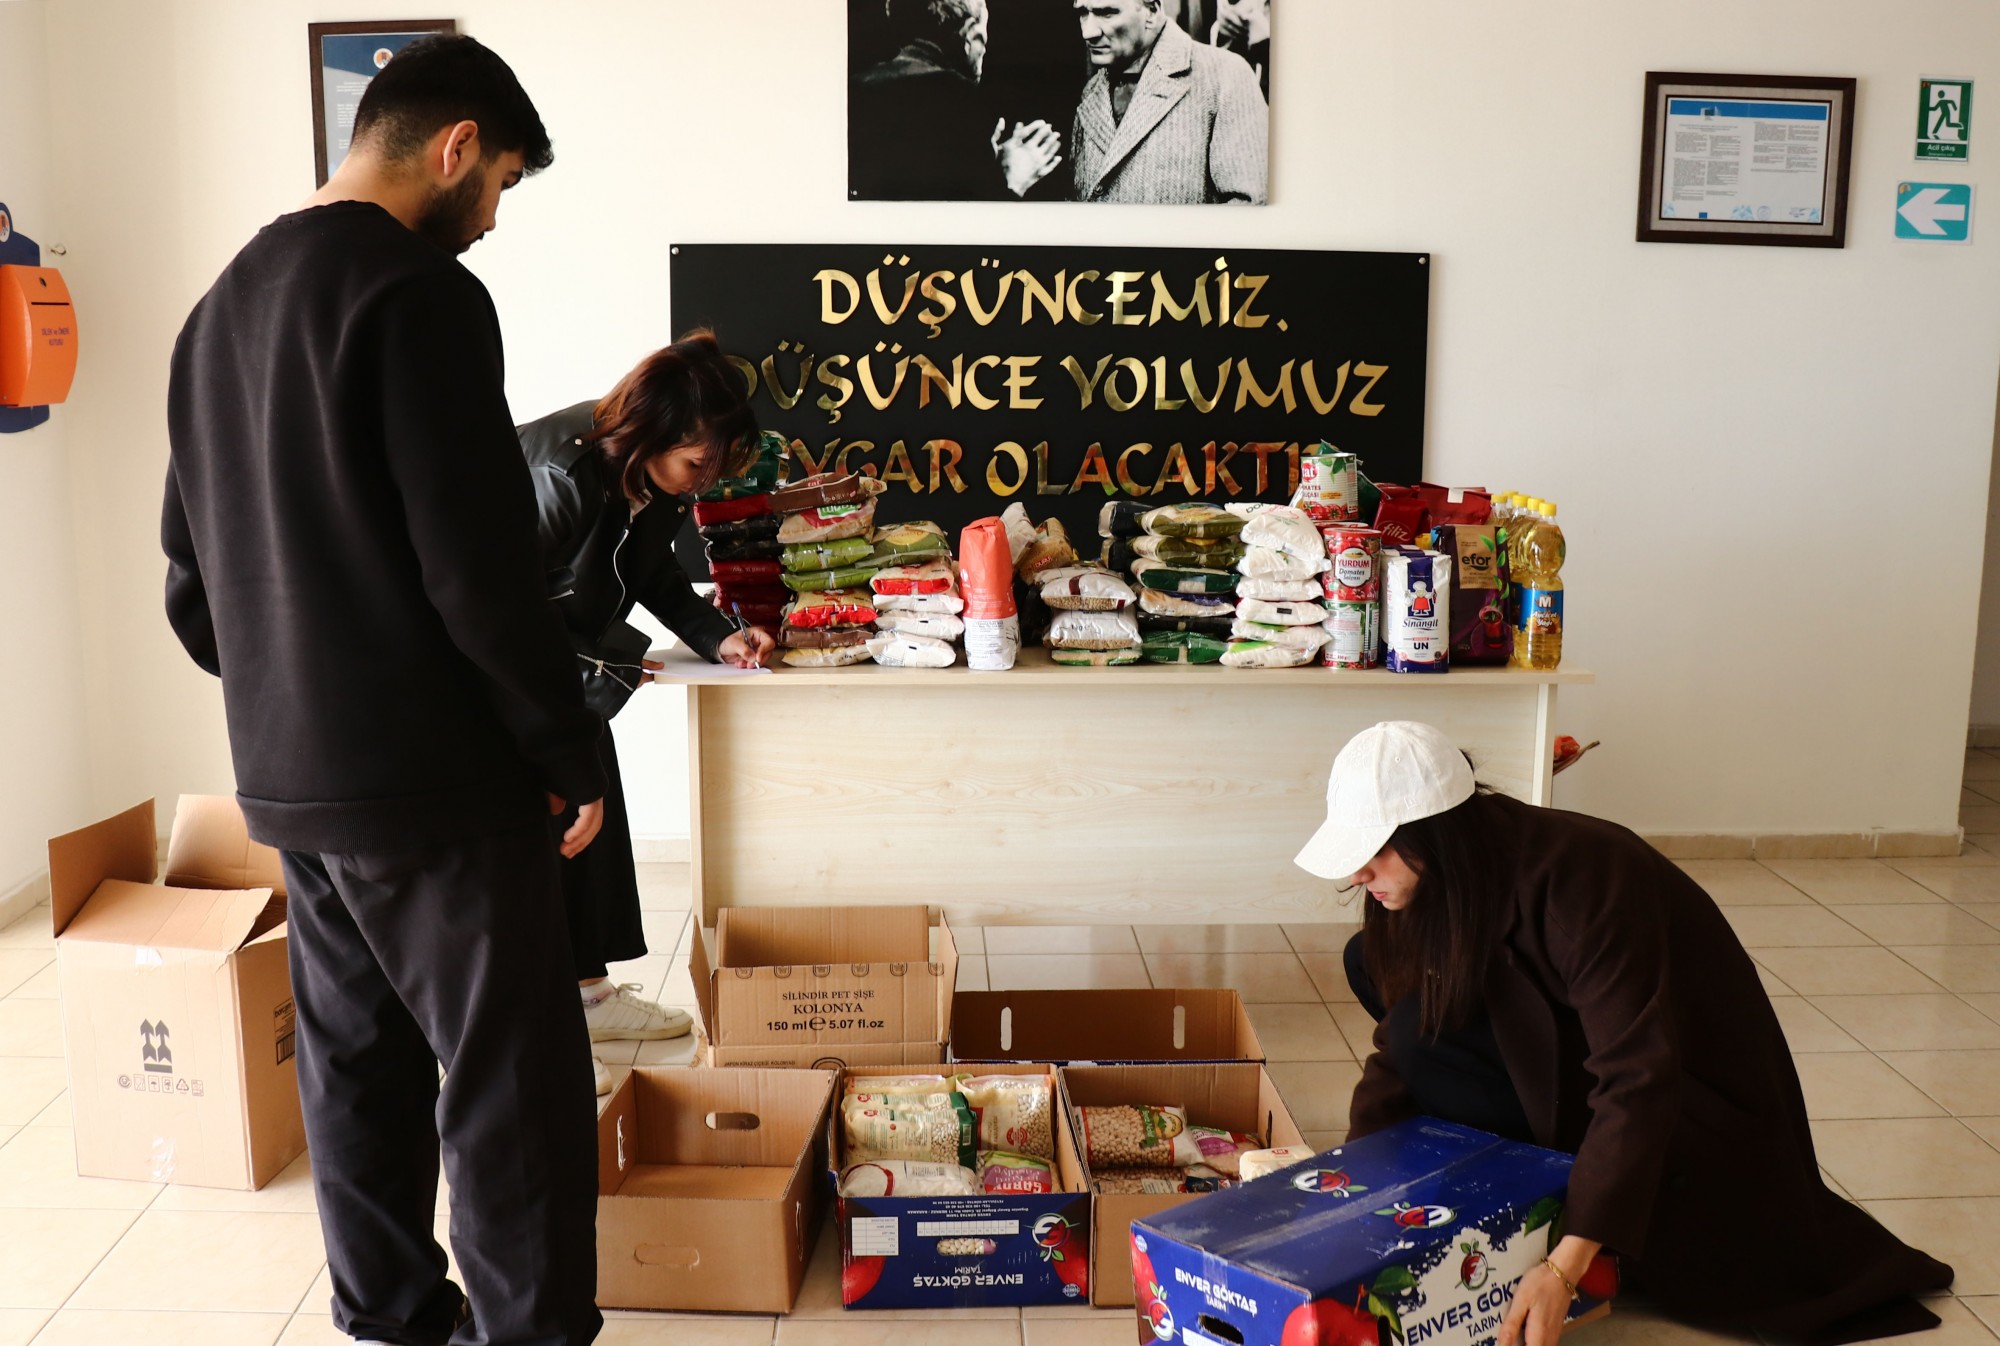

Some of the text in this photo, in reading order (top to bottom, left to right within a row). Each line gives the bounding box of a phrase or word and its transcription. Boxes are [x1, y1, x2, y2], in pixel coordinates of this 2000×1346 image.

[812, 253, 1289, 338] DÜŞÜNCEMİZ.
[1060, 352, 1390, 418] YOLUMUZ
[790, 437, 969, 495] YGAR
[1383, 523, 1408, 539] filiz
[1337, 559, 1370, 568] YURDUM
[1461, 553, 1491, 566] efor
[1339, 568, 1365, 576] Domates
[1538, 596, 1552, 608] M
[1402, 618, 1439, 629] Sinangil
[1413, 642, 1429, 650] UN
[782, 988, 875, 1001] SİLİNDİR PET ŞİŞE
[793, 1003, 864, 1015] KOLONYA
[767, 1021, 788, 1031] 150
[792, 1020, 807, 1031] ml
[829, 1019, 854, 1029] 5.07
[858, 1018, 884, 1029] fl.oz
[955, 1266, 981, 1274] TARIM
[913, 1273, 1023, 1289] ENVER GÖKTAŞ
[1175, 1267, 1258, 1318] ENVER GÖKTAŞ
[1206, 1294, 1227, 1312] TARIM
[1406, 1302, 1473, 1346] ENVER
[1466, 1312, 1503, 1338] TARIM
